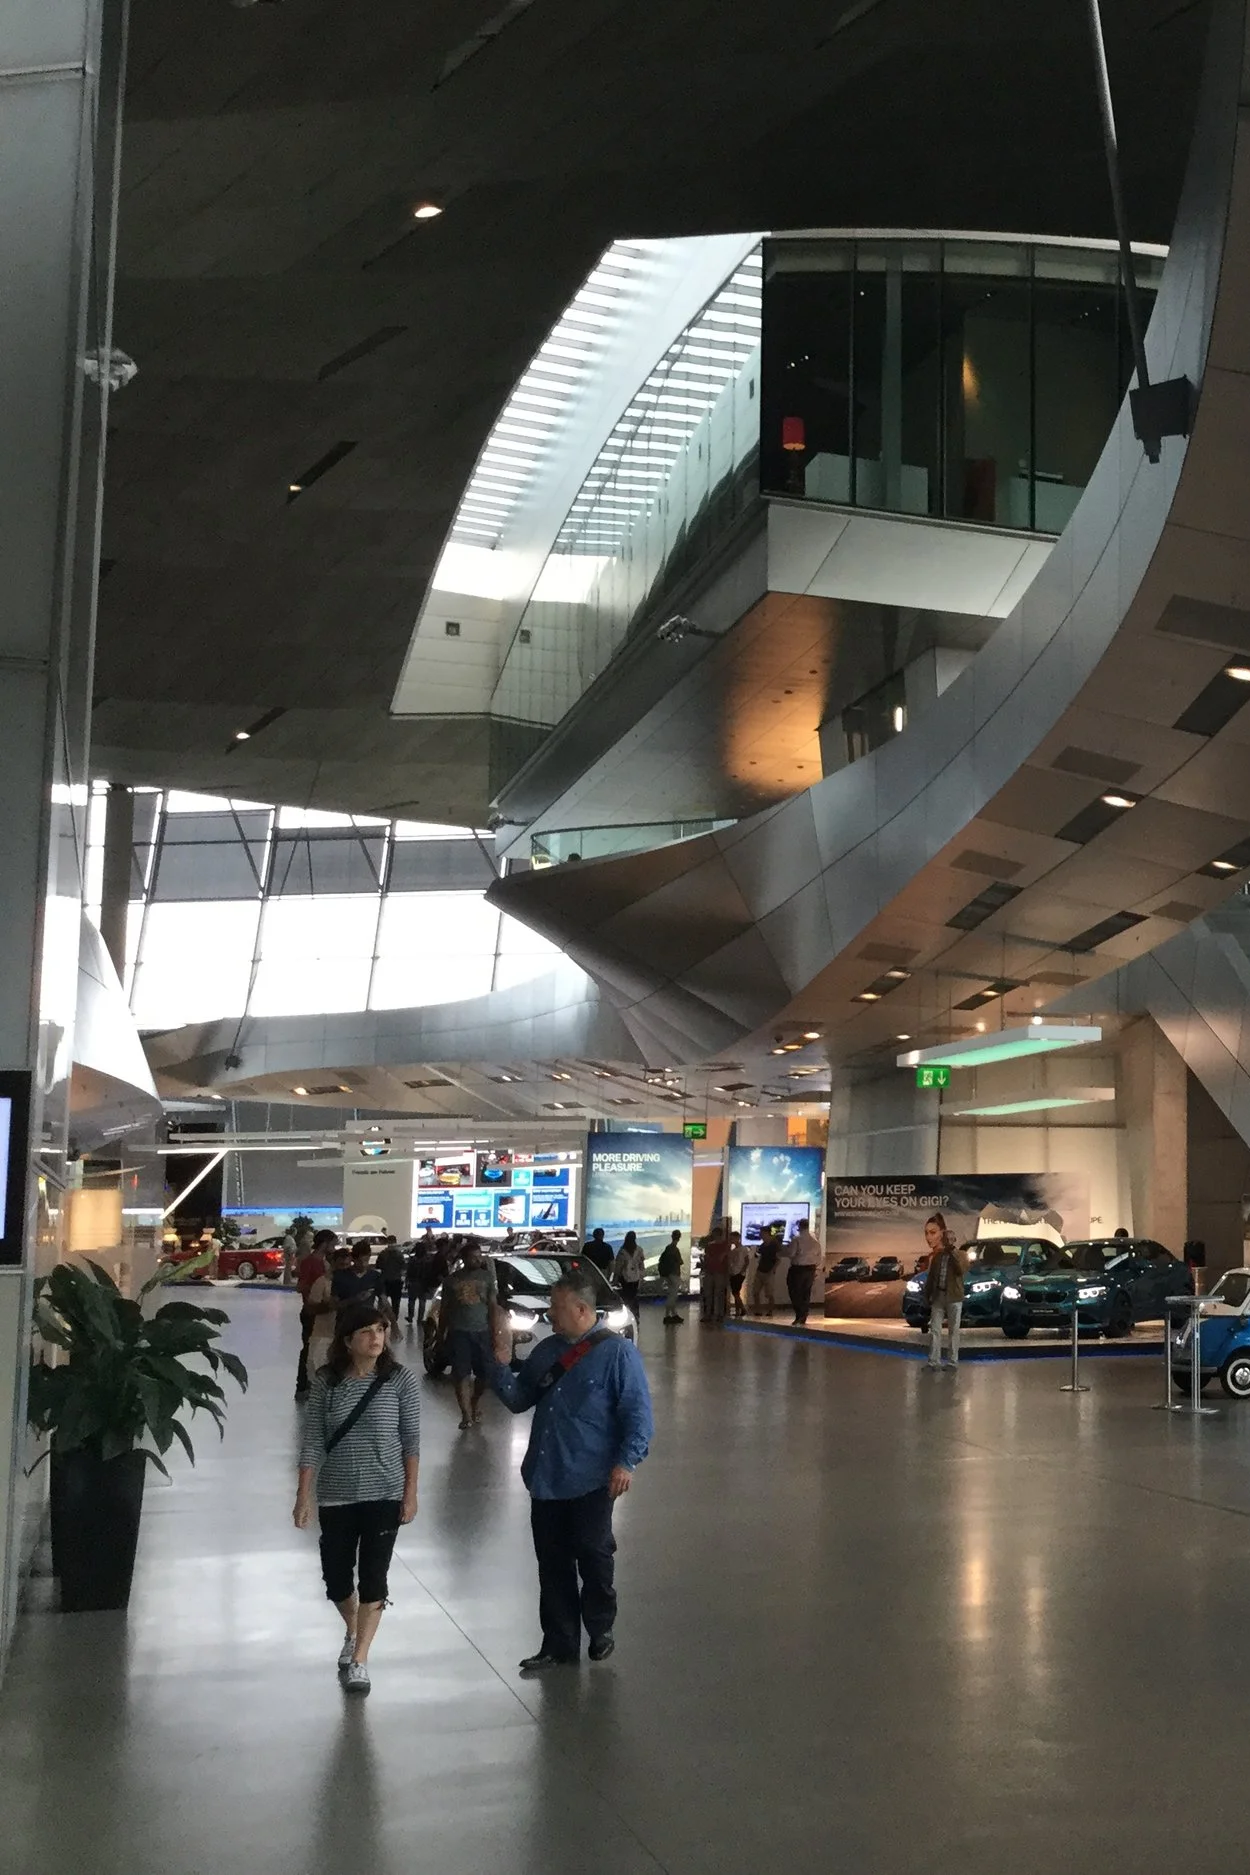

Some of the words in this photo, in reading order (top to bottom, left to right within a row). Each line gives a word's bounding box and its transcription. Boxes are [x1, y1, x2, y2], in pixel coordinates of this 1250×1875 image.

[592, 1153, 621, 1162] MORE
[622, 1153, 660, 1162] DRIVING
[592, 1162, 645, 1172] PLEASURE.
[834, 1185, 858, 1196] CAN
[860, 1184, 883, 1196] YOU
[886, 1184, 916, 1195] KEEP
[834, 1197, 866, 1208] YOUR
[867, 1196, 898, 1208] EYES
[900, 1196, 917, 1207] ON
[920, 1195, 949, 1207] GIGI?
